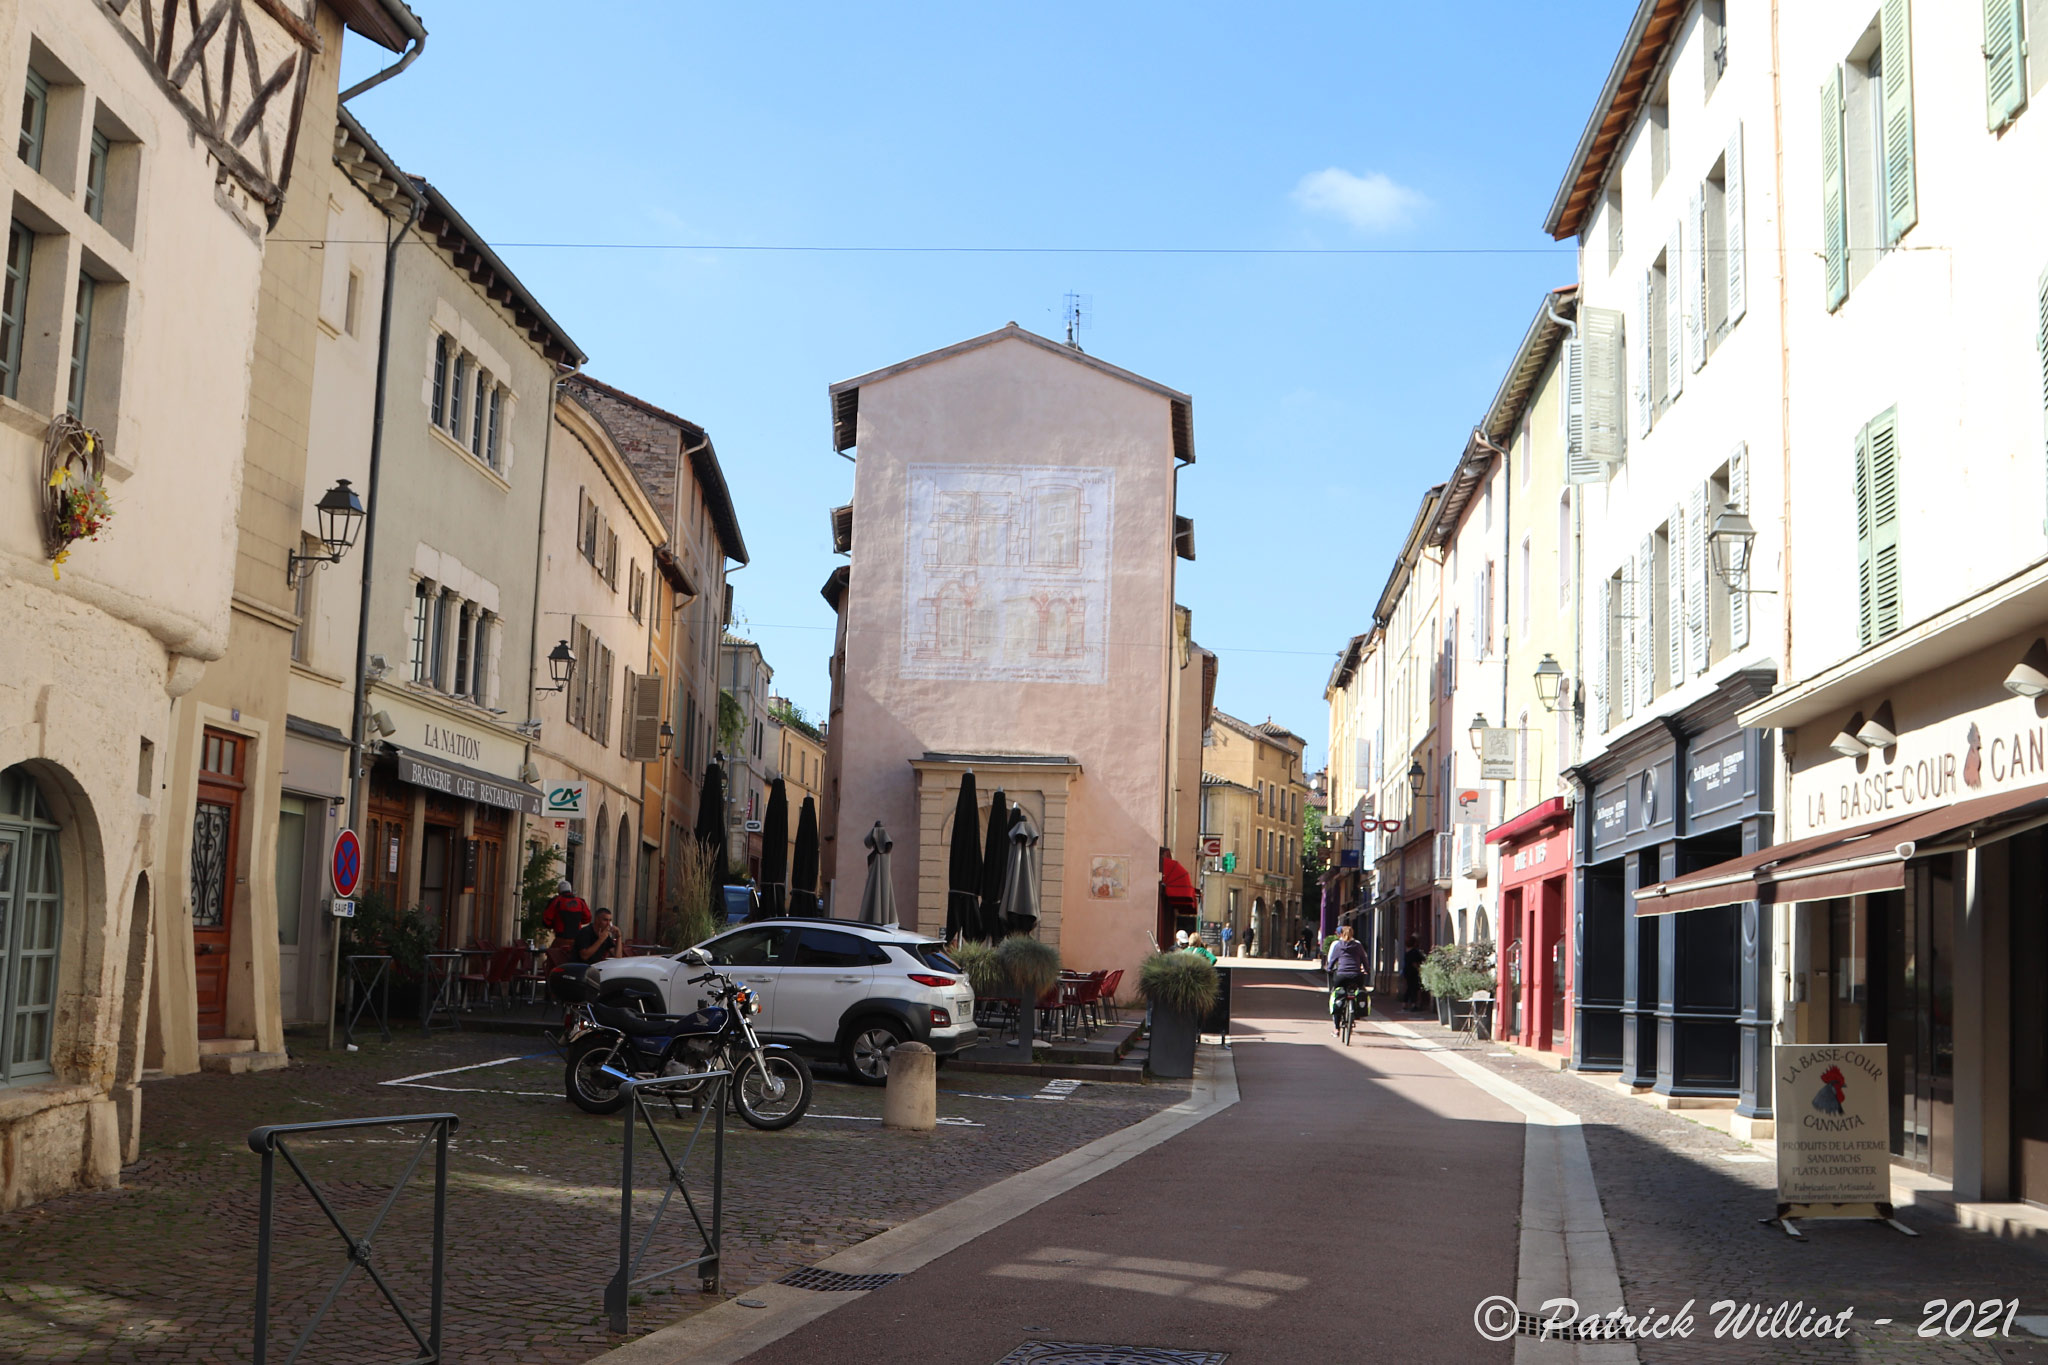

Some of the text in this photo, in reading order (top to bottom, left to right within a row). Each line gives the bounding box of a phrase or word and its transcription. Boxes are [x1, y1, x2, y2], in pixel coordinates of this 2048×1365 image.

[424, 724, 481, 761] LA NATION
[411, 763, 524, 811] BRASSERIE CAFE RESTAURANT
[1808, 726, 2044, 828] LA BASSE-COUR CAN
[1782, 1048, 1883, 1084] LA BASSE-COUR
[1803, 1114, 1865, 1132] CANNATA
[1782, 1140, 1886, 1151] PRODUITS DE LA FERME
[1807, 1153, 1861, 1163] SANDWICHS
[1792, 1166, 1877, 1176] PLATS A EMPORTER
